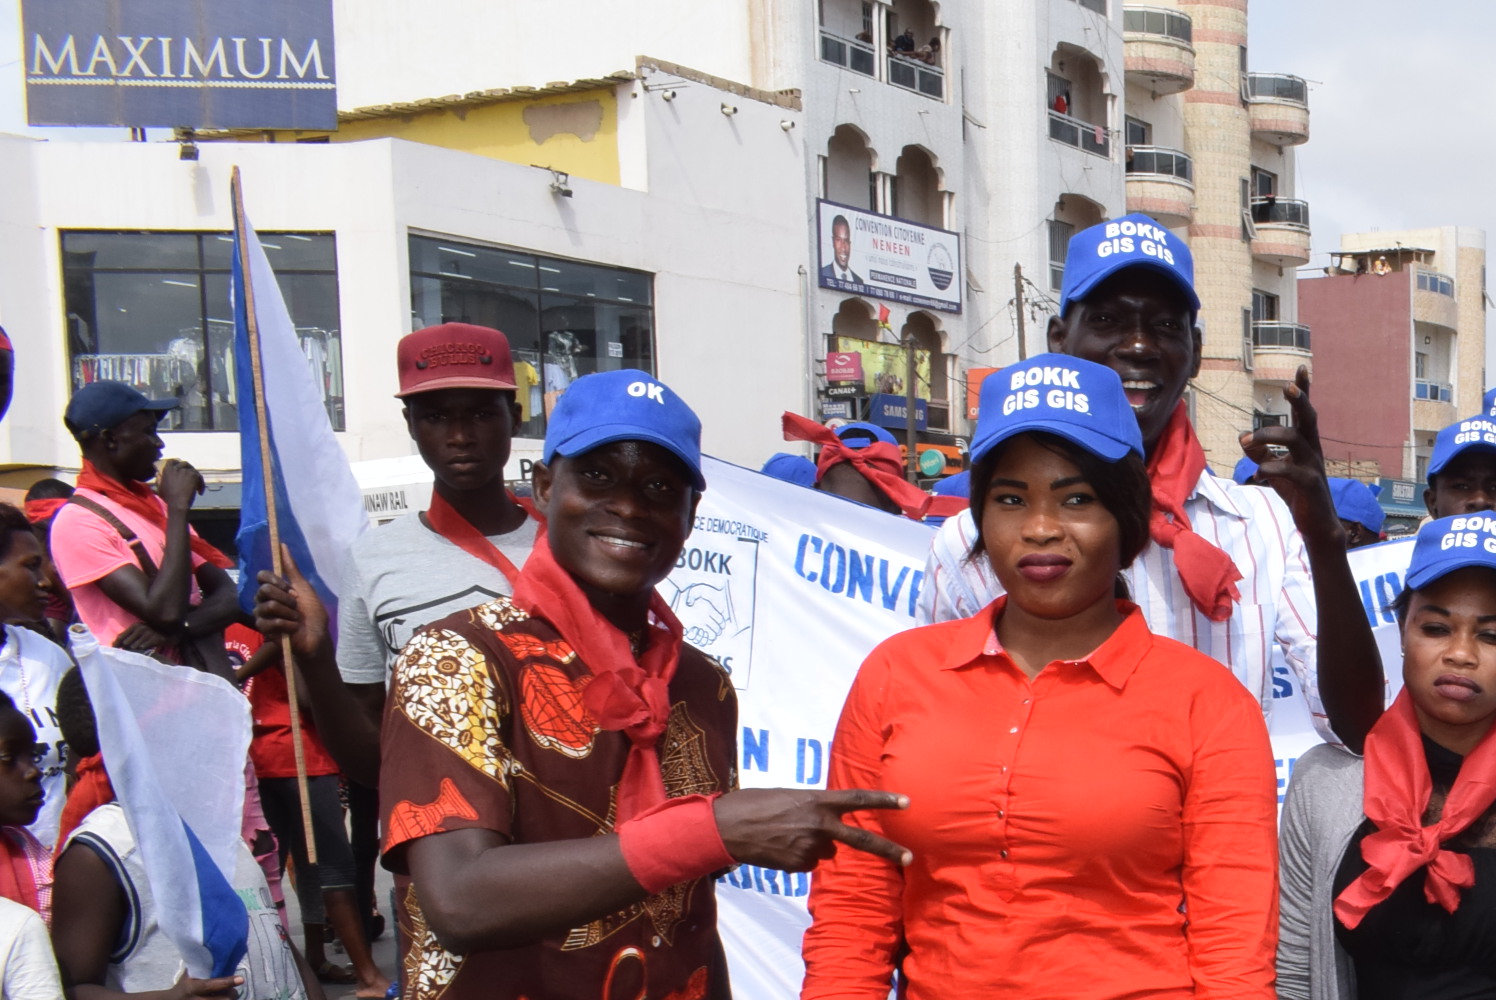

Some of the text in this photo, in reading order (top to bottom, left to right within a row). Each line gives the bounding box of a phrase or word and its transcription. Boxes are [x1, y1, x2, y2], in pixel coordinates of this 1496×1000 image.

[30, 34, 330, 78] MAXIMUM
[855, 217, 925, 245] CONVENTION CITOYENNE
[1105, 221, 1167, 245] BOKK
[872, 238, 910, 256] NENEEN
[1097, 237, 1174, 265] GIS GIS
[421, 343, 486, 359] CHICAGO
[430, 353, 476, 369] BULLS
[1010, 366, 1080, 390] BOKK
[627, 382, 664, 405] OK
[828, 386, 857, 395] CANAL+
[884, 405, 924, 420] SAMSG
[1003, 389, 1089, 416] GIS GIS
[1455, 431, 1480, 445] GIS
[390, 491, 408, 510] RAIL
[707, 517, 768, 543] DEMOCRATIQUE
[1441, 533, 1478, 551] GIS
